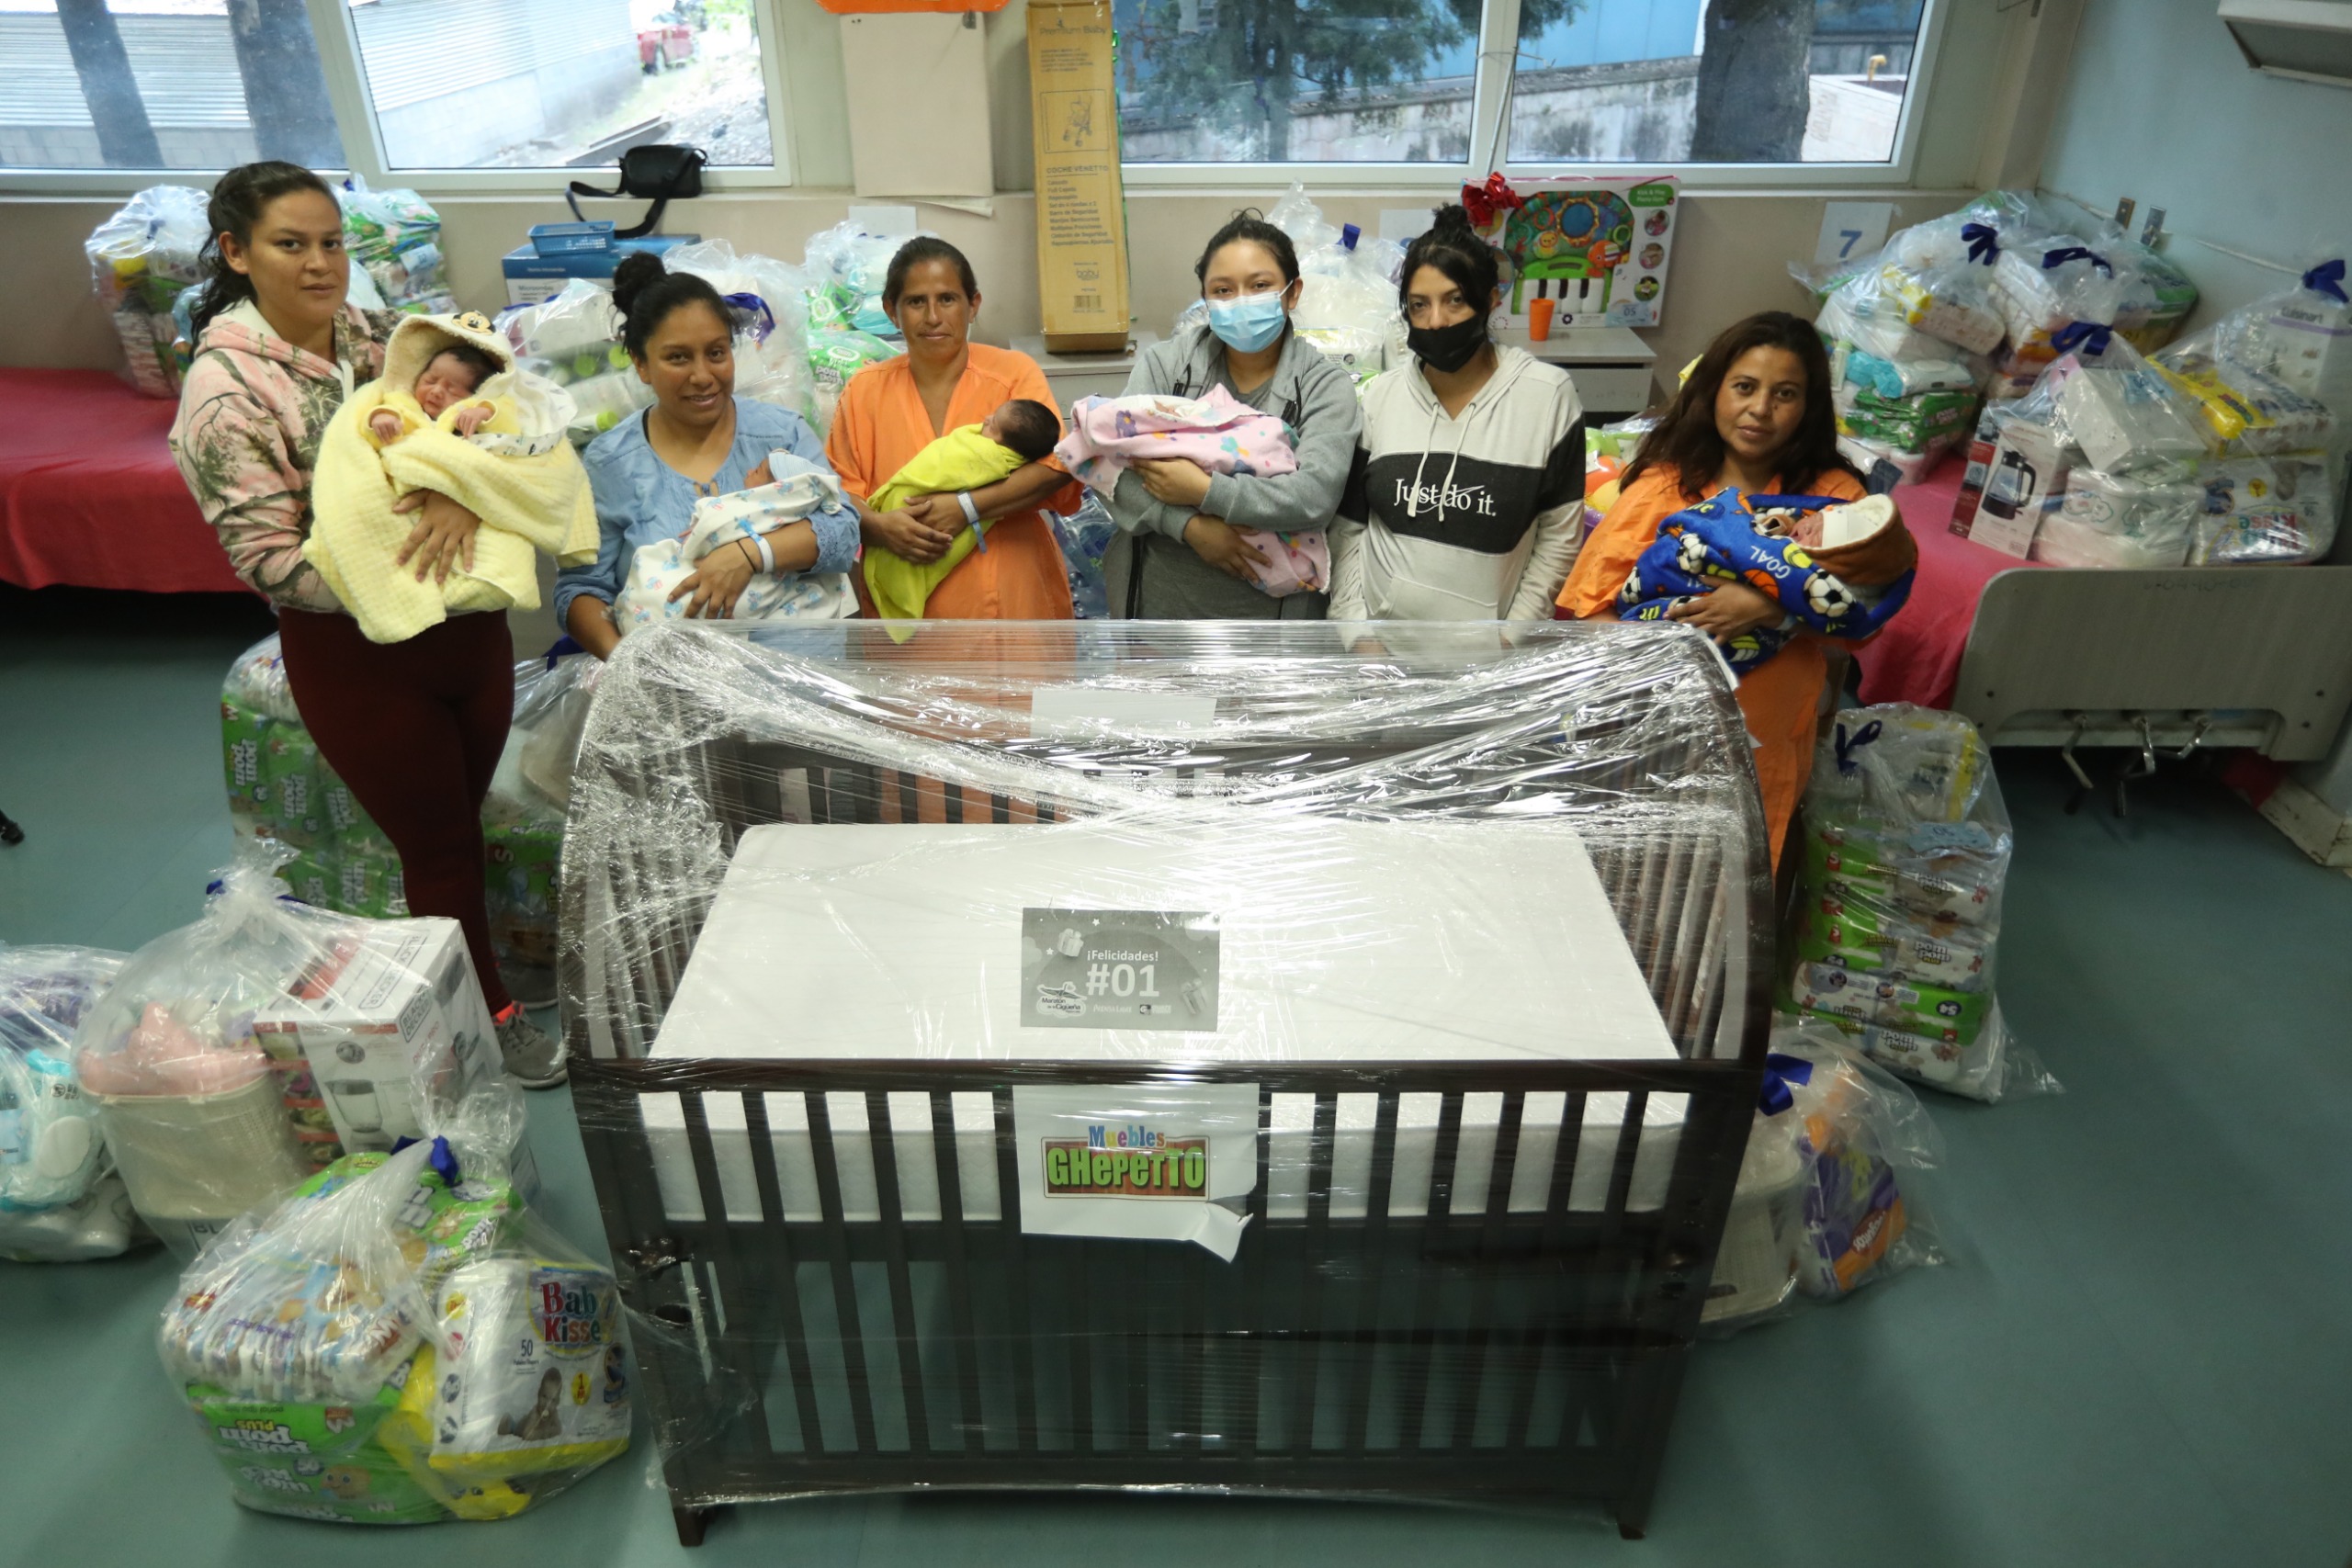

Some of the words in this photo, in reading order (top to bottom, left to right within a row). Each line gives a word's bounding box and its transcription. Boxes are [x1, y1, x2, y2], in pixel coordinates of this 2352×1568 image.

[1839, 230, 1862, 258] 7
[1394, 479, 1438, 506] Just
[1443, 484, 1471, 510] do
[1476, 491, 1497, 516] it.
[1749, 545, 1791, 580] GOAL
[1087, 949, 1159, 962] ¡Felicidades!
[1916, 941, 1948, 955] pom
[1917, 949, 1951, 963] pom
[1086, 963, 1159, 998] #01
[1041, 996, 1067, 1004] Maratón
[1056, 1002, 1081, 1012] Cigüeña
[1089, 1125, 1166, 1147] Muebles
[541, 1281, 605, 1316] Bab
[521, 1339, 533, 1357] 50
[235, 1419, 274, 1430] PLUS
